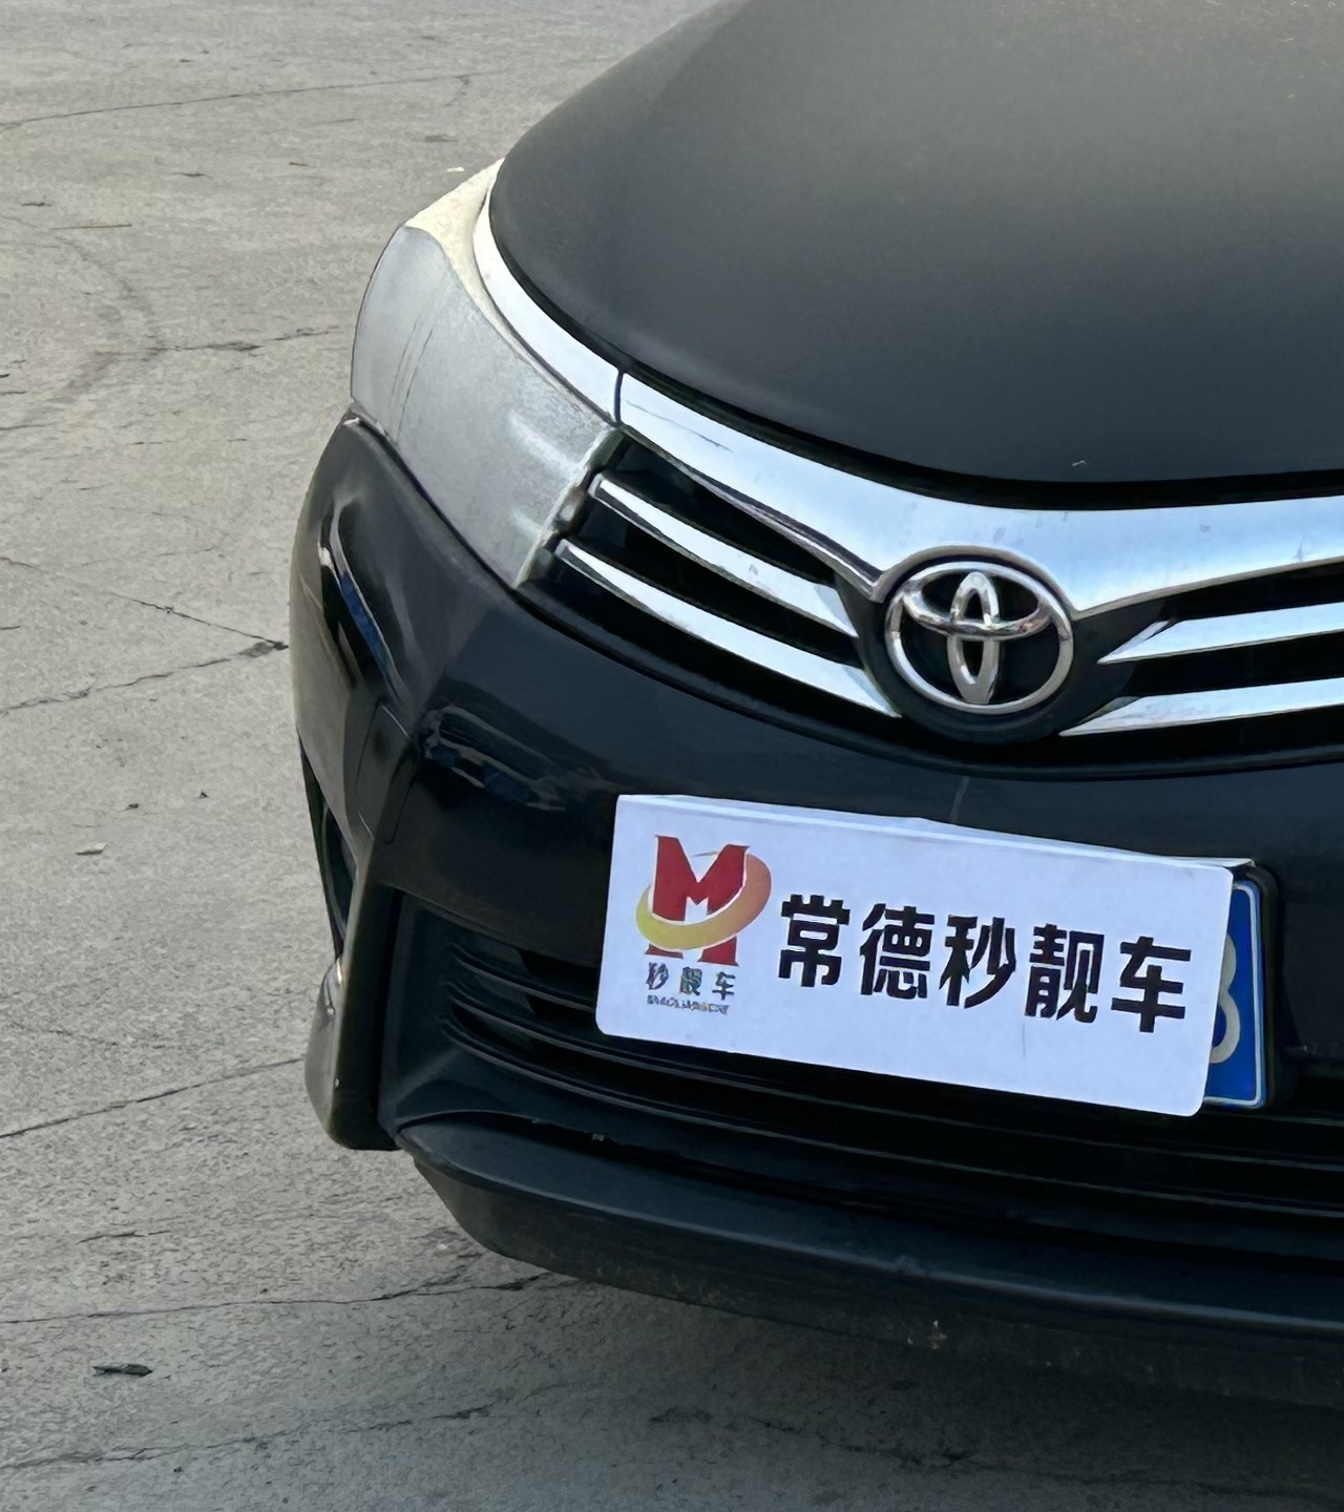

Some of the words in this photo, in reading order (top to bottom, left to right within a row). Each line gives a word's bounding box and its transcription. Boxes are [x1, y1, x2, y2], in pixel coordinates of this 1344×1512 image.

[778, 893, 1192, 1033] 常德秒靓车
